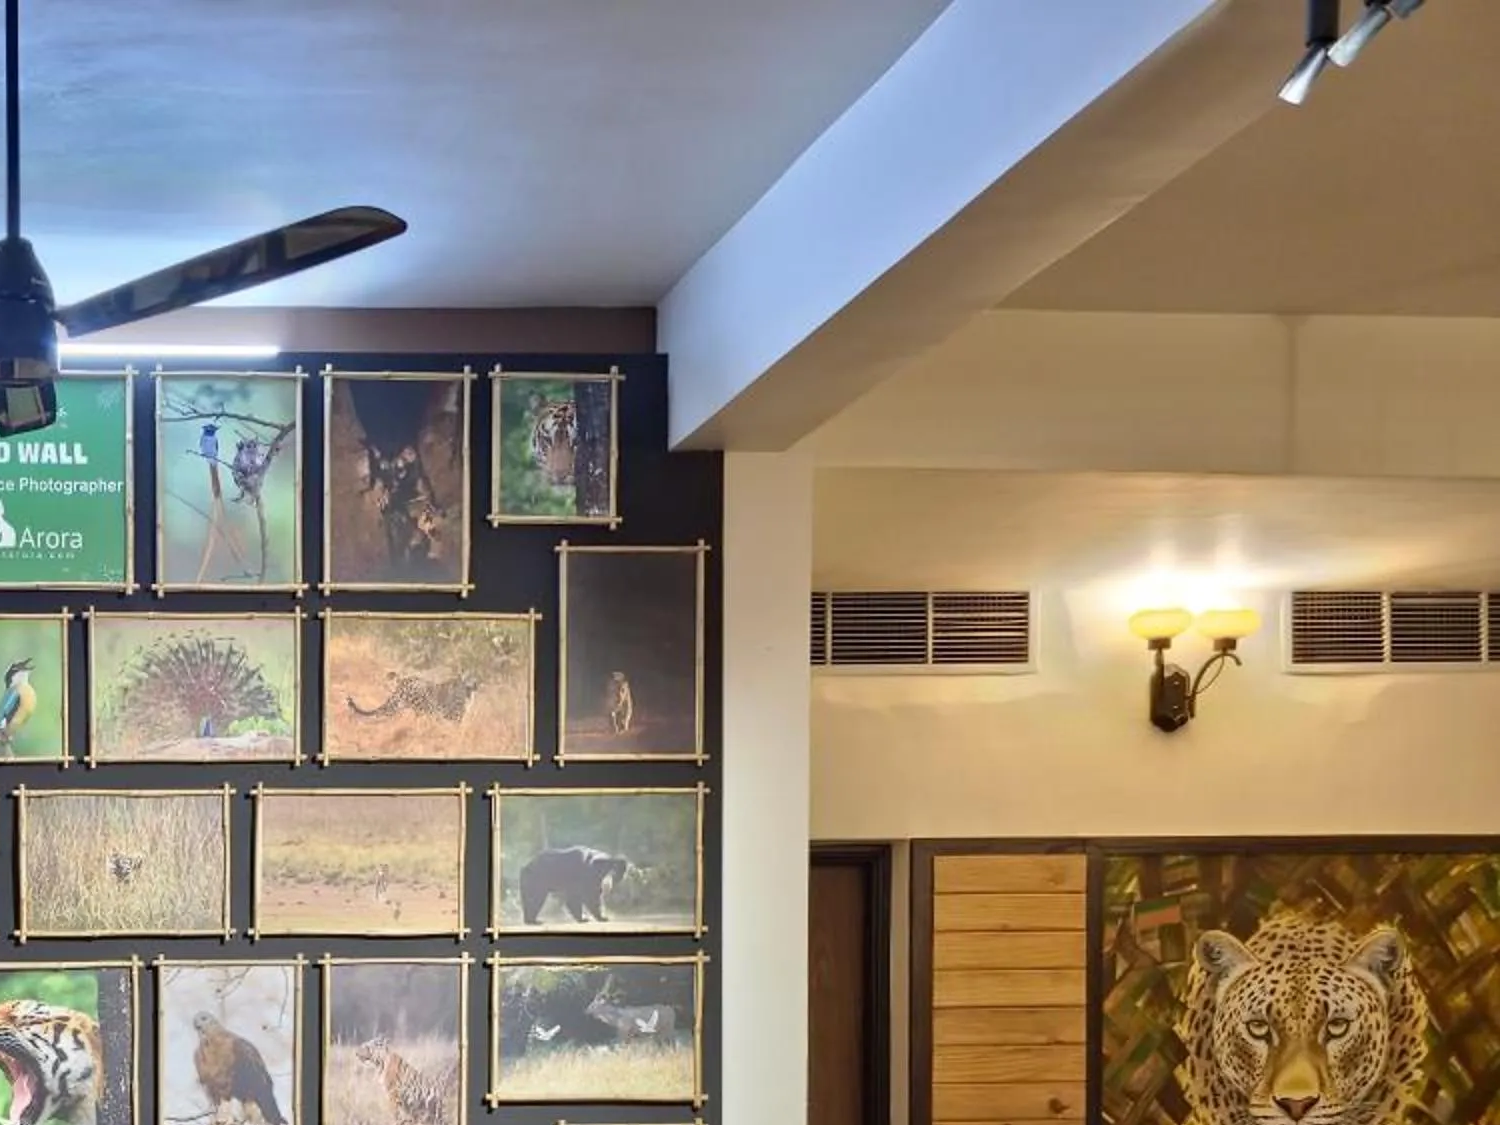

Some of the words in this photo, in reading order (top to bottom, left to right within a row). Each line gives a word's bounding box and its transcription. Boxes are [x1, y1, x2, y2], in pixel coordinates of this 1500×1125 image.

[18, 442, 88, 465] WALL
[19, 477, 124, 494] Photographer
[19, 527, 83, 549] Arora
